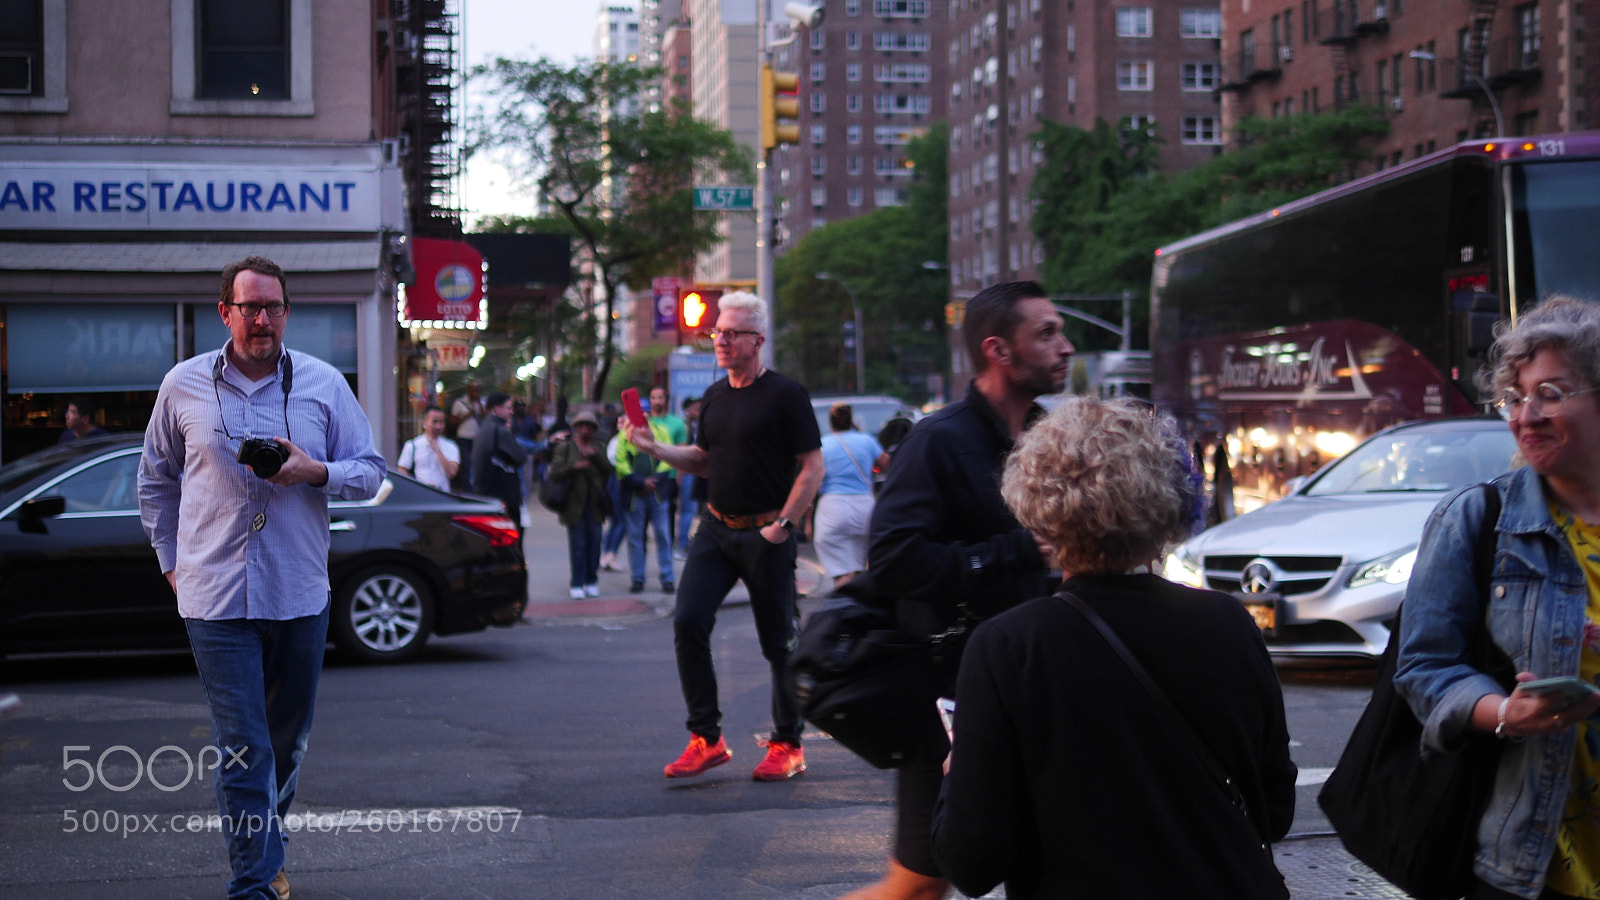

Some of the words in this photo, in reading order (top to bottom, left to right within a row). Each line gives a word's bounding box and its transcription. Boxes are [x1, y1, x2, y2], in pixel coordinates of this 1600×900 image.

[1537, 140, 1565, 156] 131
[0, 181, 57, 212] AR
[73, 182, 356, 212] RESTAURANT
[436, 303, 472, 314] LOTTO
